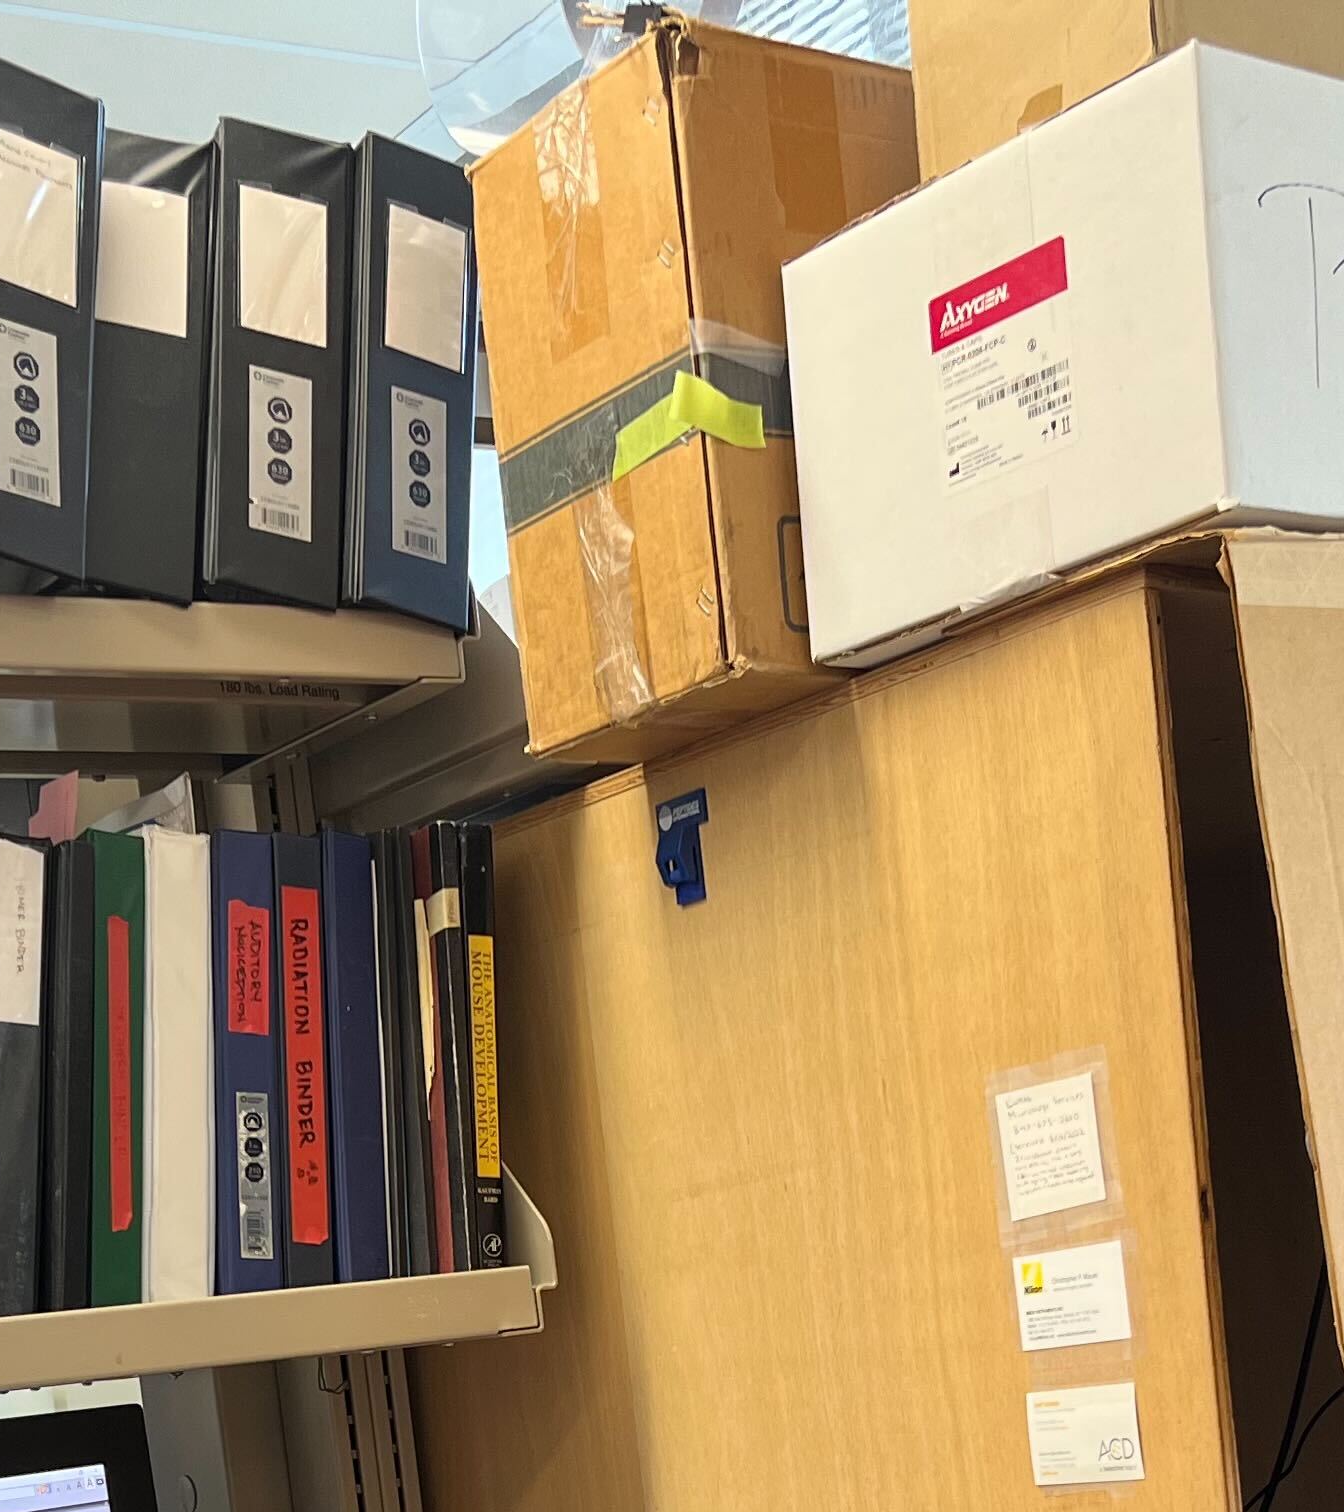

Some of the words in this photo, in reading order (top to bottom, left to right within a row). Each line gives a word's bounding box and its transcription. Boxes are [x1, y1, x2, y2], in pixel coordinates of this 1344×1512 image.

[940, 282, 1008, 333] AXYGEN
[220, 682, 241, 694] 180
[269, 683, 298, 696] Load
[301, 685, 340, 699] Rating
[249, 920, 263, 1002] AUDITORY
[290, 918, 310, 1035] RADIATION
[471, 951, 483, 1019] MOUSE
[482, 951, 493, 974] THE
[483, 980, 496, 1091] ANATOMICAL
[296, 1060, 316, 1149] BINDER
[473, 1024, 491, 1163] DEVELOPMENT
[487, 1095, 498, 1138] BASIS
[490, 1143, 499, 1163] OF
[1098, 1437, 1135, 1462] ACD
